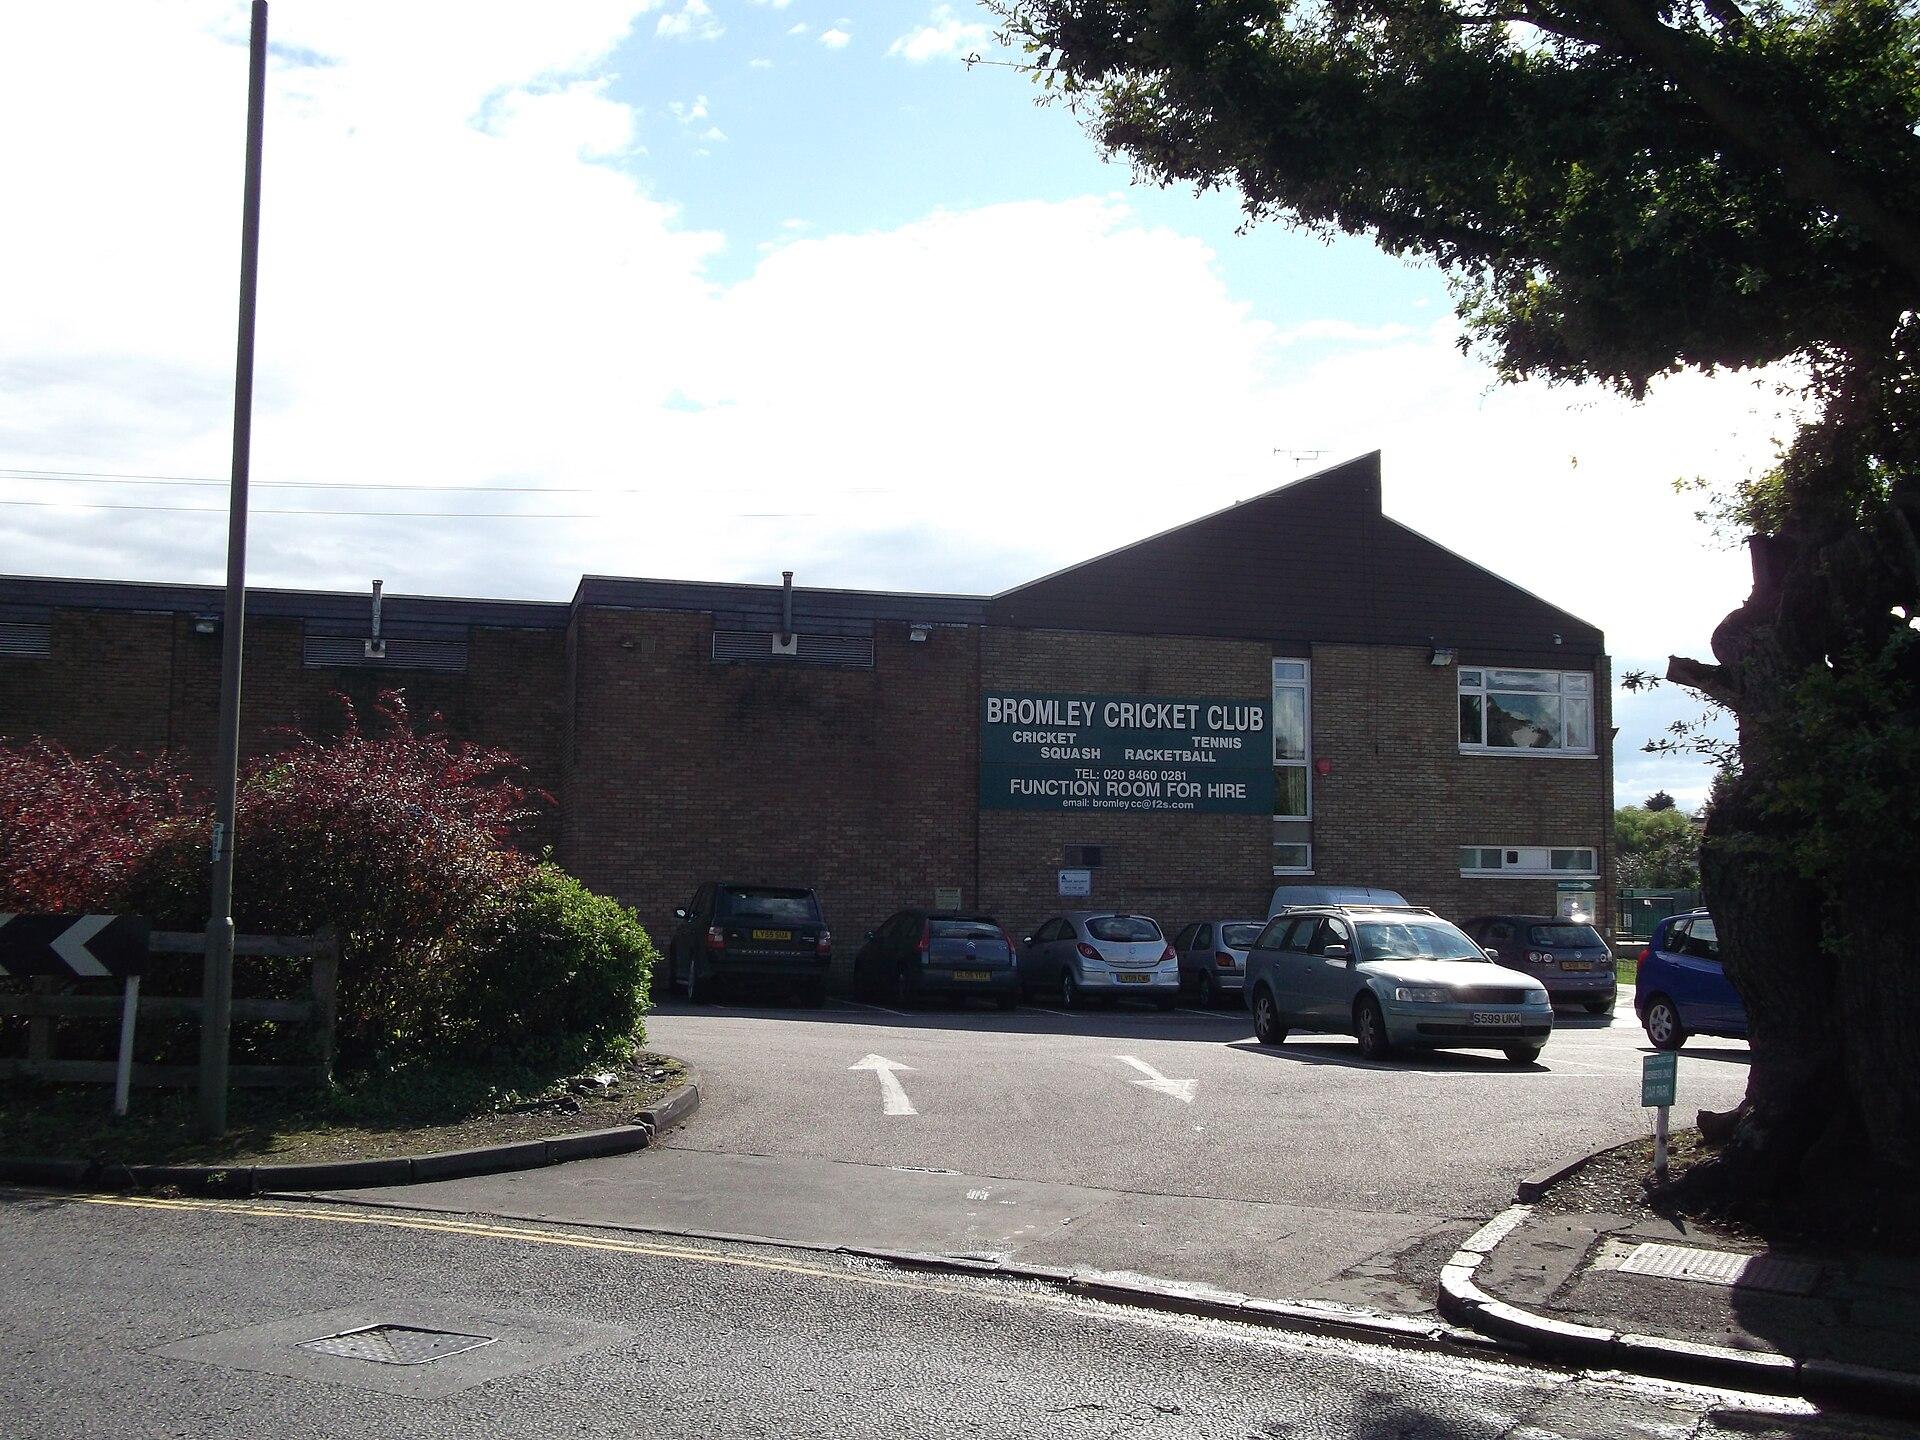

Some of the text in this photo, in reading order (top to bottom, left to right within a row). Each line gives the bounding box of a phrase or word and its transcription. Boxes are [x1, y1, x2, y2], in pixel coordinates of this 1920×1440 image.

[987, 697, 1264, 731] BROMLEY CRICKET CLUB
[1012, 731, 1242, 749] CRICKET TENNIS
[1040, 747, 1217, 762] SQUASH RACKETBALL
[1075, 768, 1187, 781] TEL: 020 8460 0281
[1010, 779, 1247, 799] FUNCTION ROOM FOR HIRE
[1062, 798, 1090, 808] email:
[1474, 1013, 1521, 1024] S599 UKK
